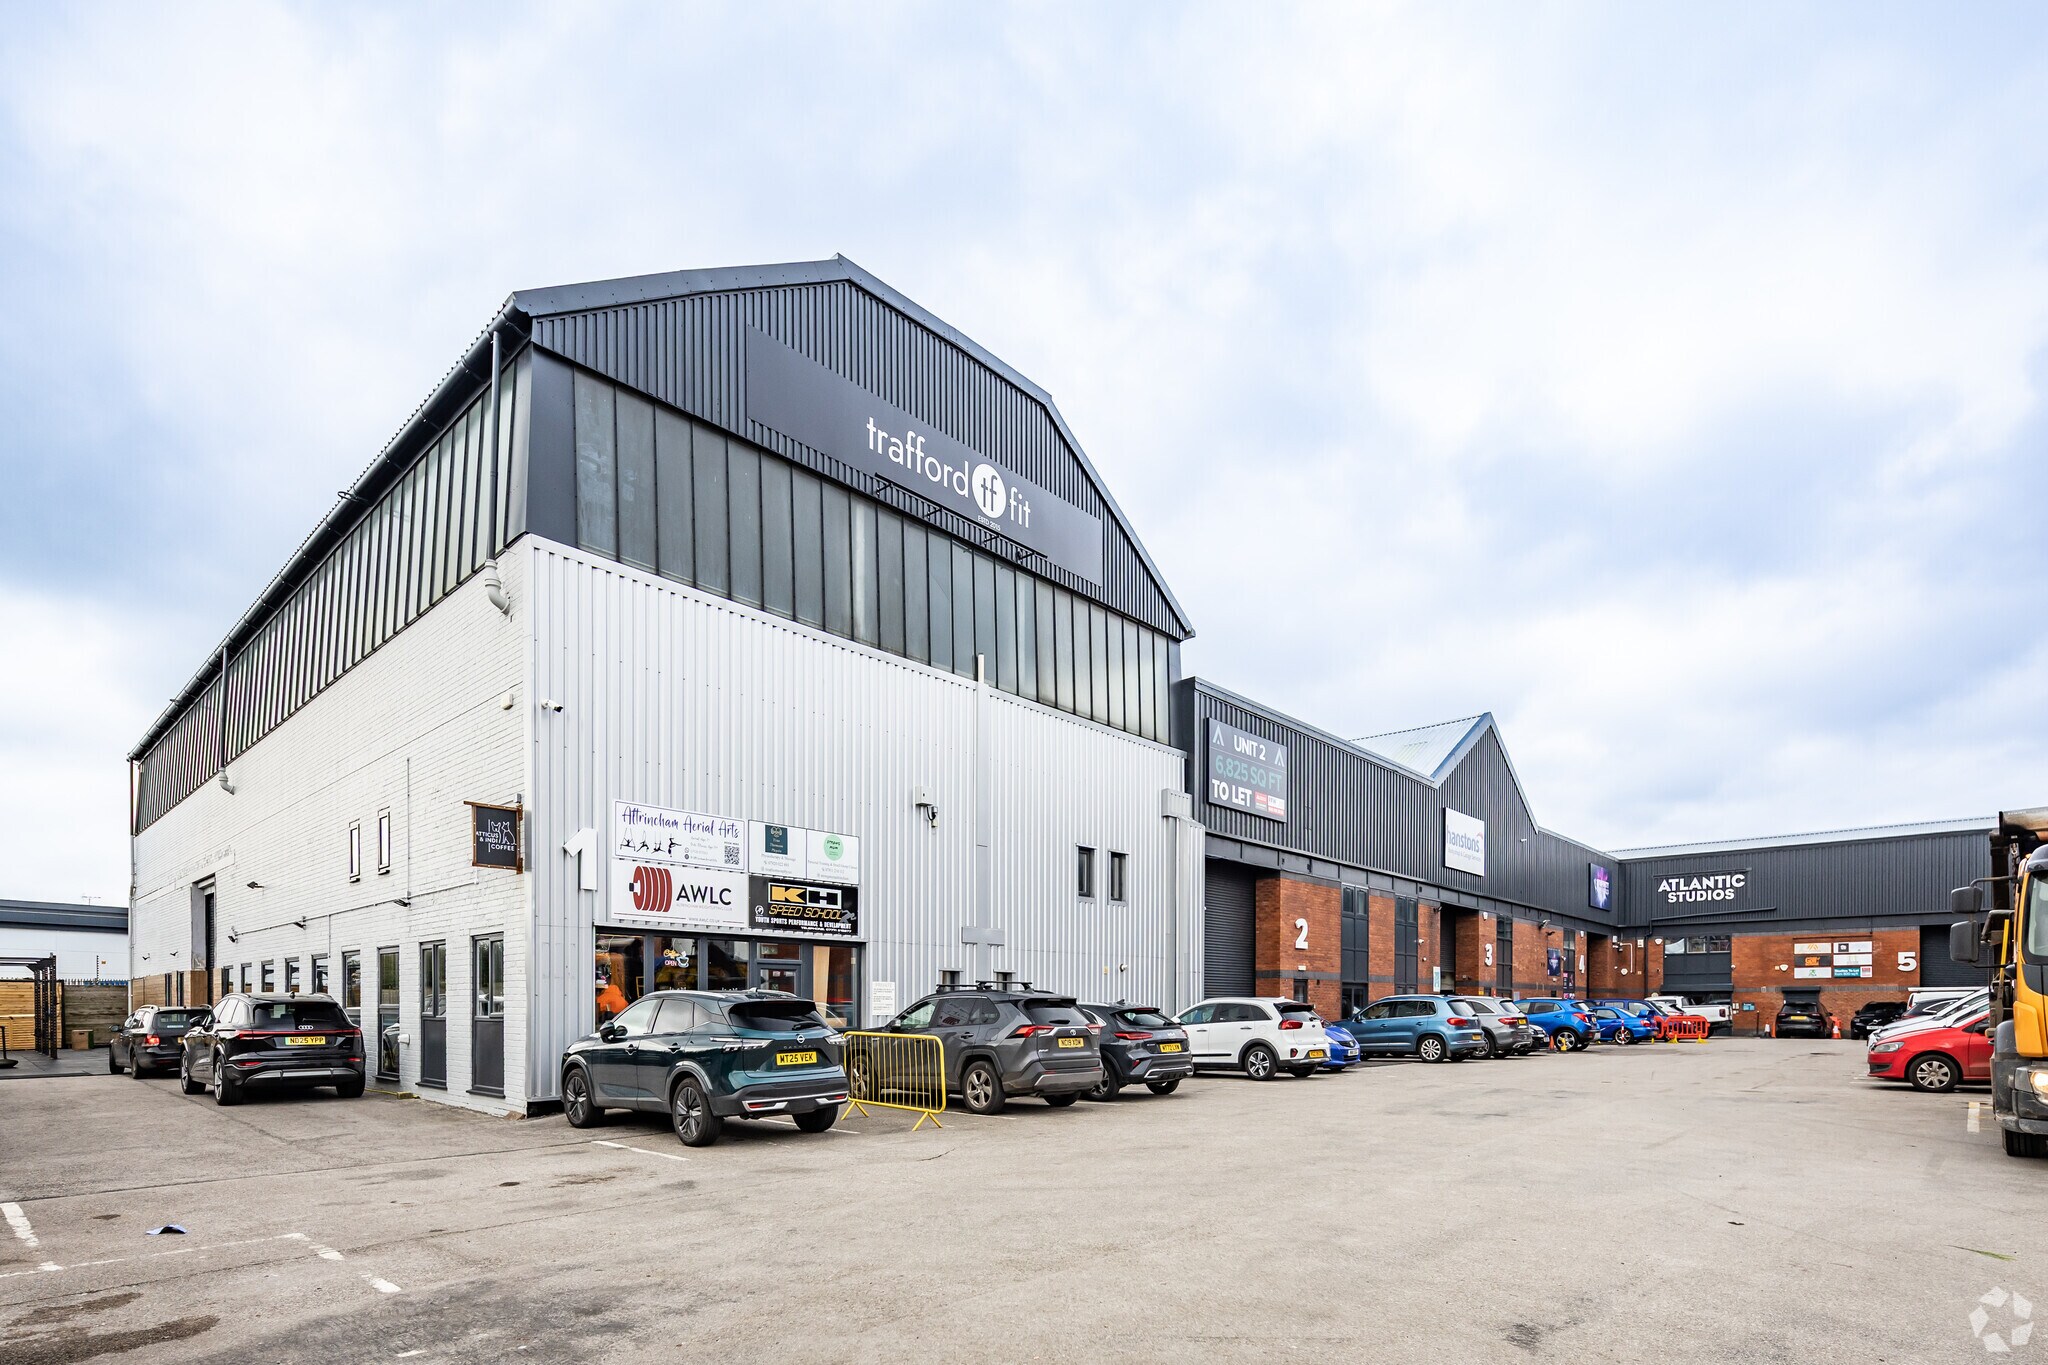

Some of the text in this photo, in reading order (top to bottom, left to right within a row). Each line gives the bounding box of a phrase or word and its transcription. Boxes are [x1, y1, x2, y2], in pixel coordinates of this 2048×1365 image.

[866, 416, 969, 498] trafford
[1009, 486, 1031, 528] fit
[1233, 734, 1266, 761] UNIT 2
[1215, 754, 1282, 792] 6,825 SQ FT
[1211, 778, 1229, 801] TO
[1231, 784, 1252, 808] LET
[622, 805, 740, 839] Altrincham Aerial Arts
[476, 831, 499, 839] ATTICUS
[1446, 824, 1480, 853] hanstons
[490, 843, 515, 852] COFFEE
[561, 827, 597, 891] 1
[1657, 874, 1745, 892] ATLANTIC
[676, 883, 732, 906] AWLC
[772, 886, 839, 906] KH
[1668, 888, 1735, 903] STUDIOS
[768, 904, 842, 920] SPEED SCHOOL
[755, 916, 770, 924] YOUTH
[770, 917, 787, 925] SPORTS
[788, 919, 818, 927] PERFORMANCE
[824, 921, 851, 930] DEVELOPMENT
[1295, 917, 1309, 950] 2
[665, 959, 678, 967] OPEN
[1484, 943, 1493, 967] 3
[1579, 954, 1585, 974] 4
[1897, 951, 1918, 972] 5
[780, 1052, 814, 1064] MT25 VEK
